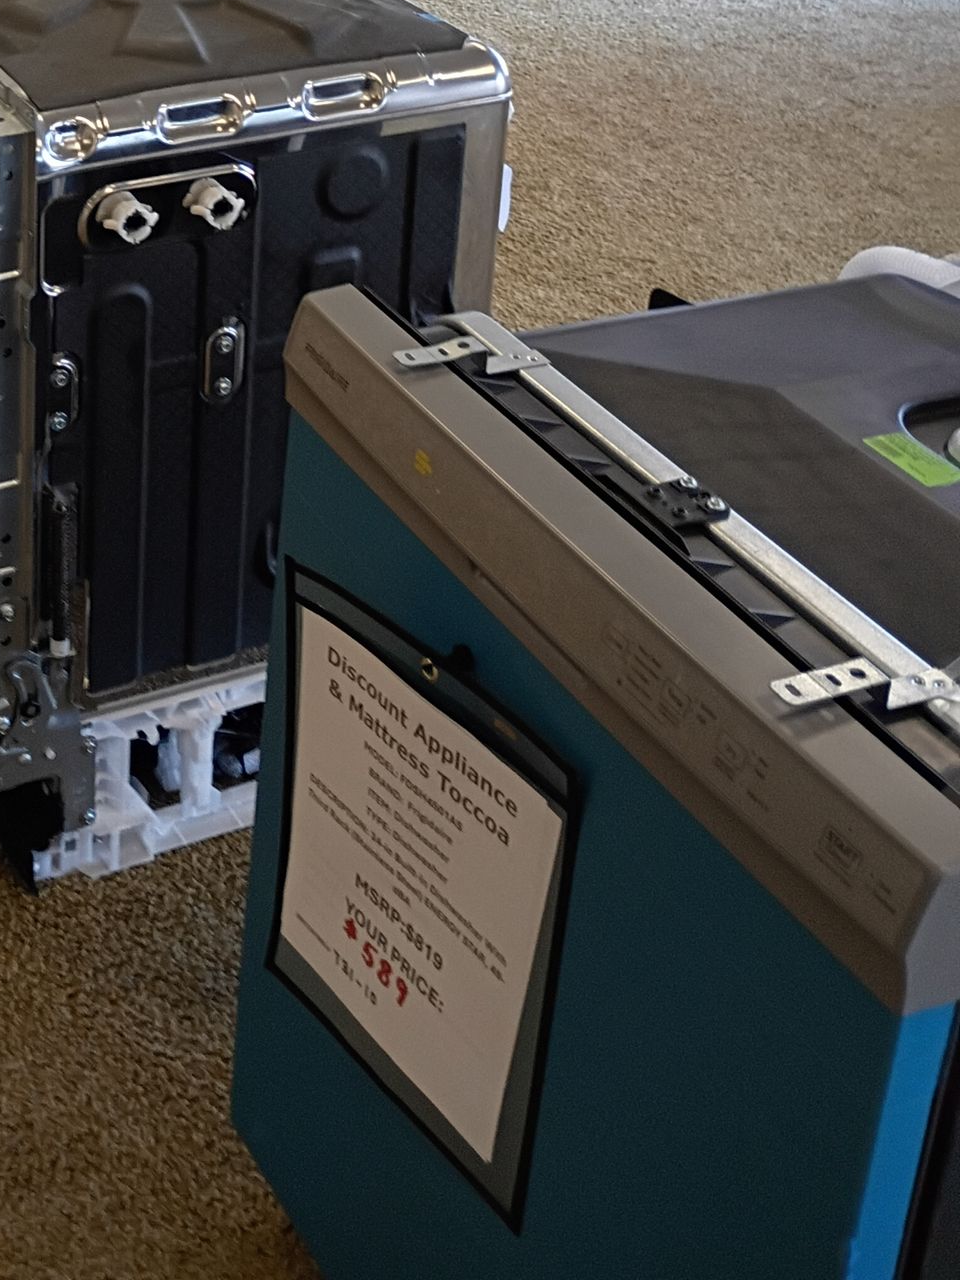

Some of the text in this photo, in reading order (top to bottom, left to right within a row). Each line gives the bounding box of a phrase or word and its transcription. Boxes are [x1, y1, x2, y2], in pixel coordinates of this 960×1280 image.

[327, 645, 518, 818] Discount Appliance
[328, 678, 510, 847] & Mattress Toccoa
[343, 917, 409, 1007] $589
[345, 896, 444, 1013] YOUR PRICE:
[355, 873, 443, 971] MSRP:$819
